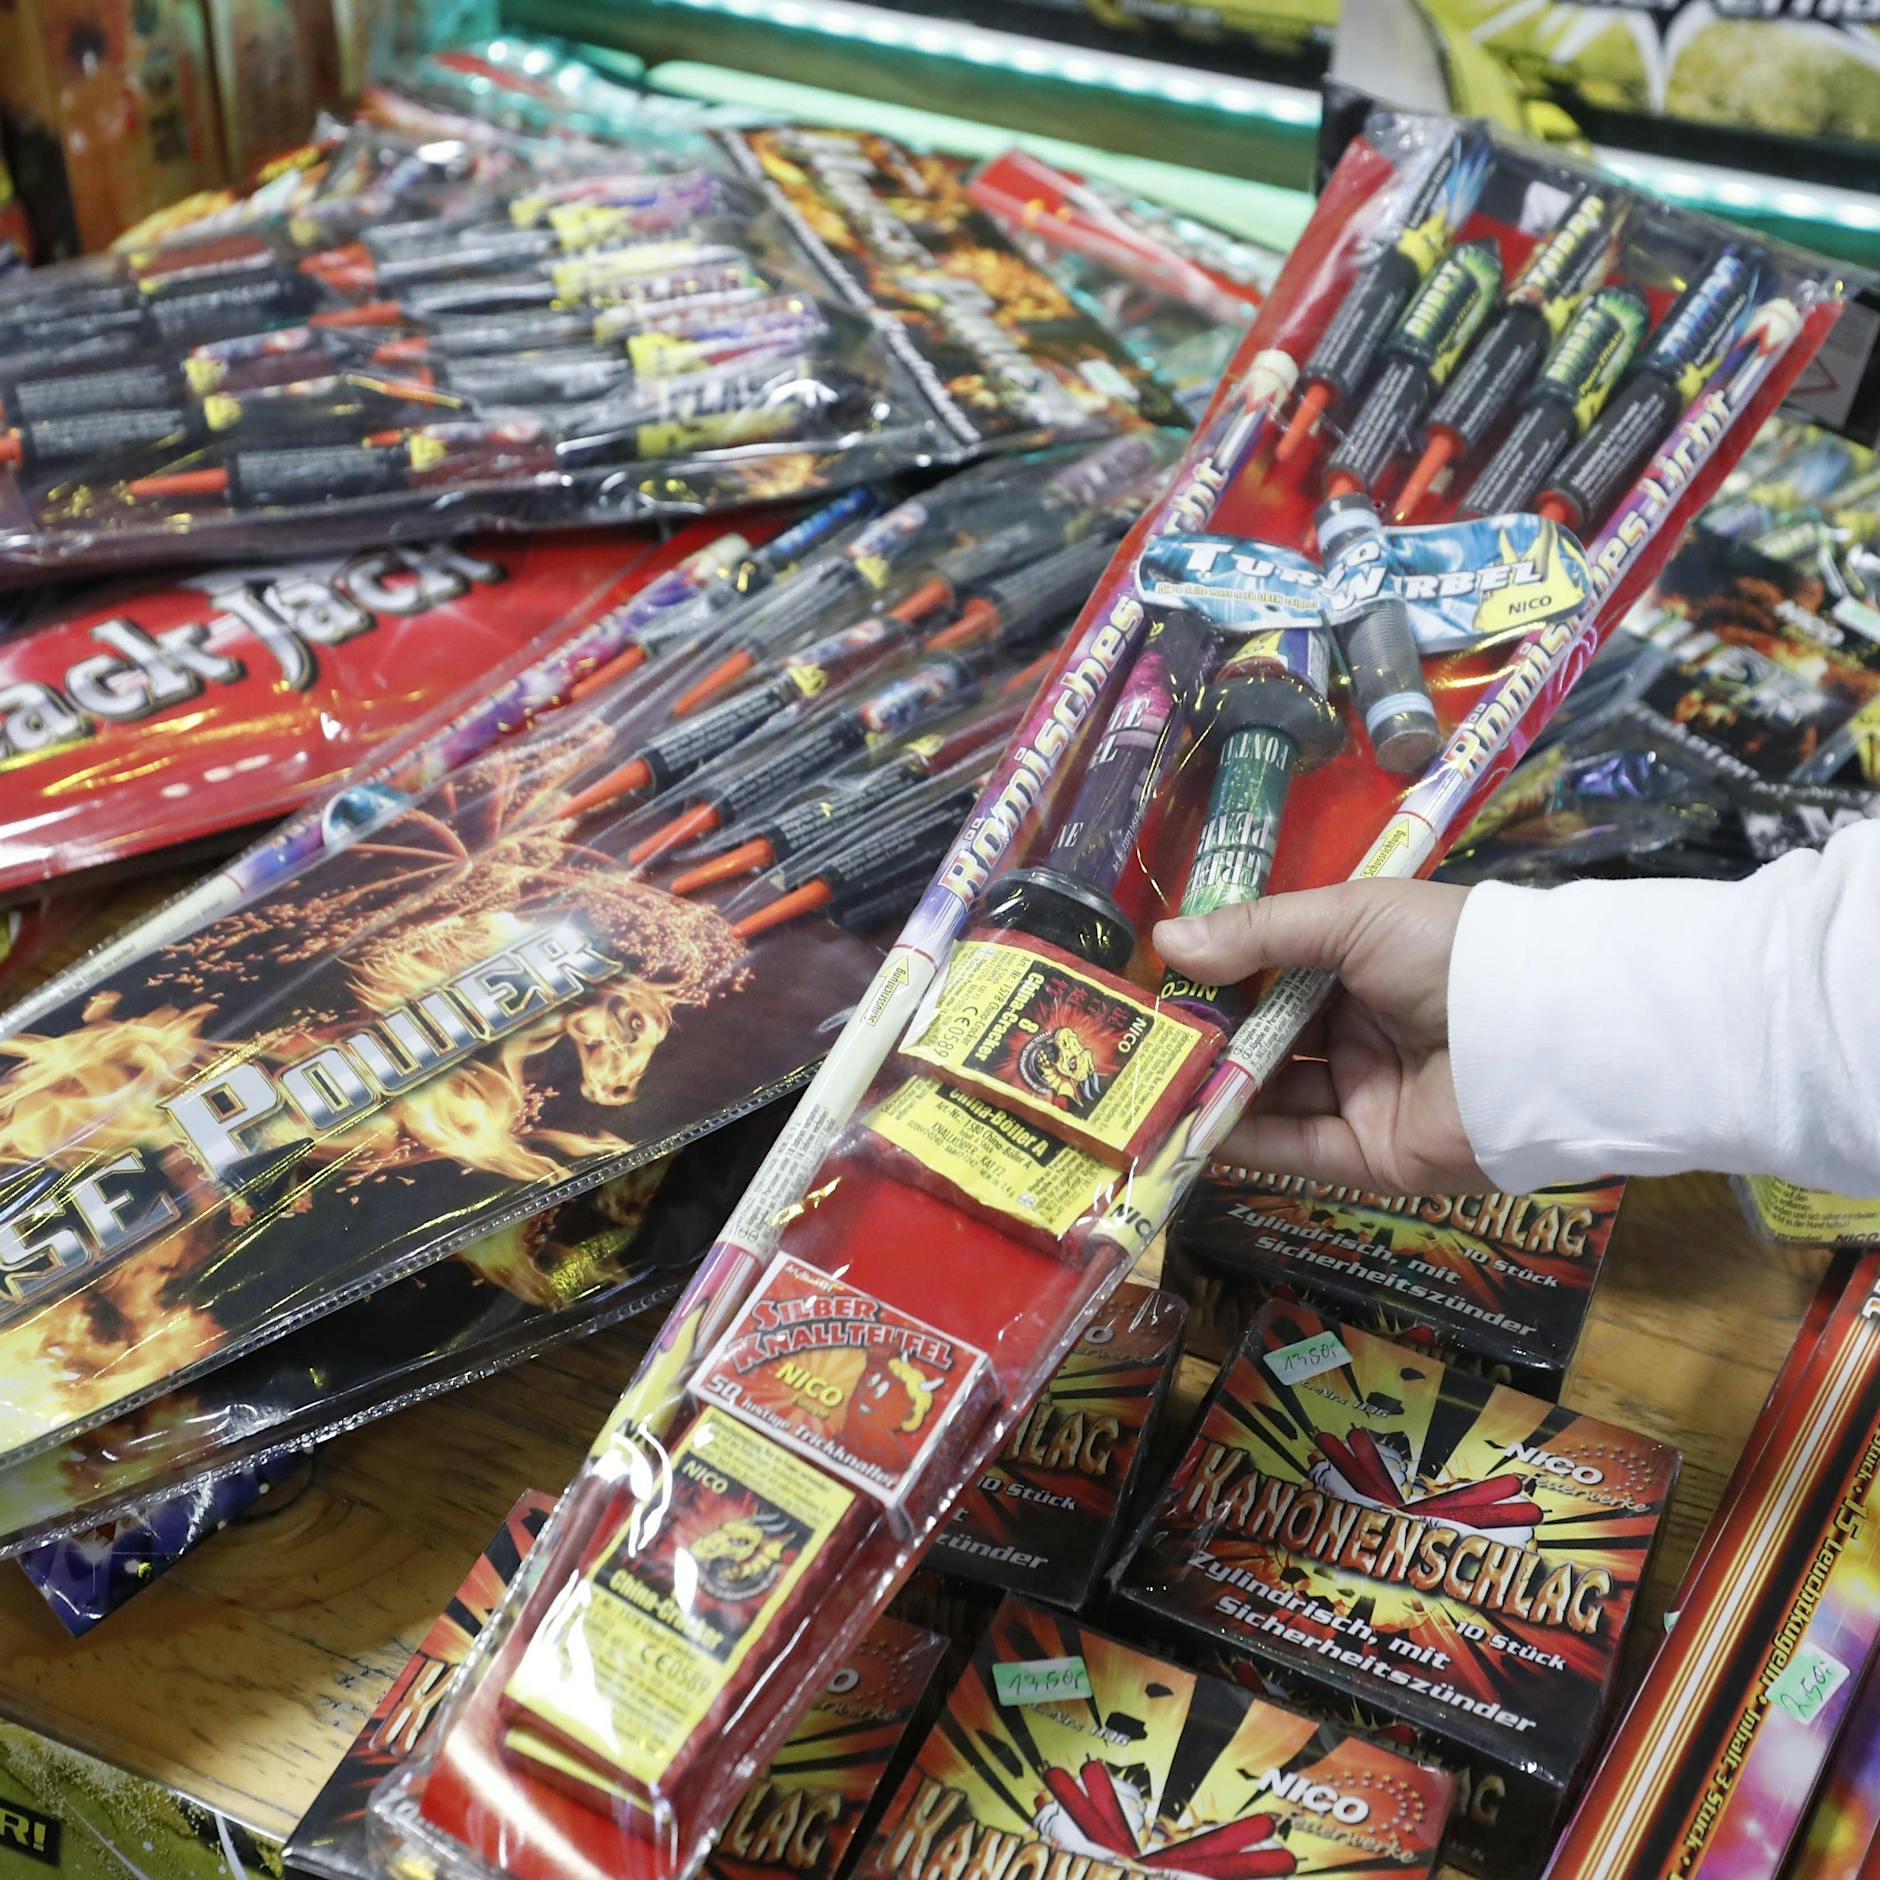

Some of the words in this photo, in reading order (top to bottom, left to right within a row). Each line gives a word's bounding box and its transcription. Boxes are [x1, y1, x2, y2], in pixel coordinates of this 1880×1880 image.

[1507, 595, 1553, 616] NICO
[936, 596, 1146, 903] Römisches
[1362, 827, 1407, 878] Schussrichtung
[992, 982, 1012, 1002] 1578
[961, 1000, 999, 1046] China-Cracker
[973, 970, 1045, 1062] China-Cracker
[1020, 1018, 1038, 1032] 8
[1117, 1016, 1147, 1053] NICO
[158, 924, 626, 1194] POWER
[932, 1024, 965, 1058] 0589
[963, 1118, 983, 1136] 1580
[1033, 1140, 1049, 1158] A
[1110, 1203, 1153, 1237] NIC
[1227, 1203, 1399, 1266] Zylindrisch,
[1408, 1258, 1463, 1286] mit
[1254, 1236, 1537, 1337] Sicherheitszünder
[1464, 1248, 1491, 1265] 10
[1493, 1259, 1559, 1288] Stück
[752, 1296, 881, 1330] SILBER
[727, 1321, 954, 1374] KNALLTEUFEL
[775, 1362, 844, 1408] NICO
[706, 1374, 743, 1403] 50
[741, 1399, 791, 1432] lustige
[796, 1424, 898, 1489] Trickknaller
[680, 1457, 730, 1496] NICO
[1503, 1441, 1604, 1485] NICO
[1006, 1484, 1077, 1511] Stück
[1520, 1472, 1650, 1514] Feuerwerke
[1183, 1441, 1613, 1634] KANONENSCHLAG
[1833, 1496, 1869, 1541] 15
[1187, 1551, 1378, 1645] Zylindrisch,
[1388, 1637, 1451, 1671] mit
[1760, 1536, 1844, 1688] Leuchtkugeln
[1215, 1596, 1538, 1733] Sicherheitszünder
[1455, 1620, 1484, 1642] 10
[1489, 1634, 1568, 1671] Stück
[1722, 1706, 1761, 1770] Inhalt
[1256, 1767, 1370, 1825] NICO
[1714, 1770, 1732, 1790] 3
[1277, 1811, 1419, 1864] Feuerwerke
[1685, 1788, 1724, 1850] Stück
